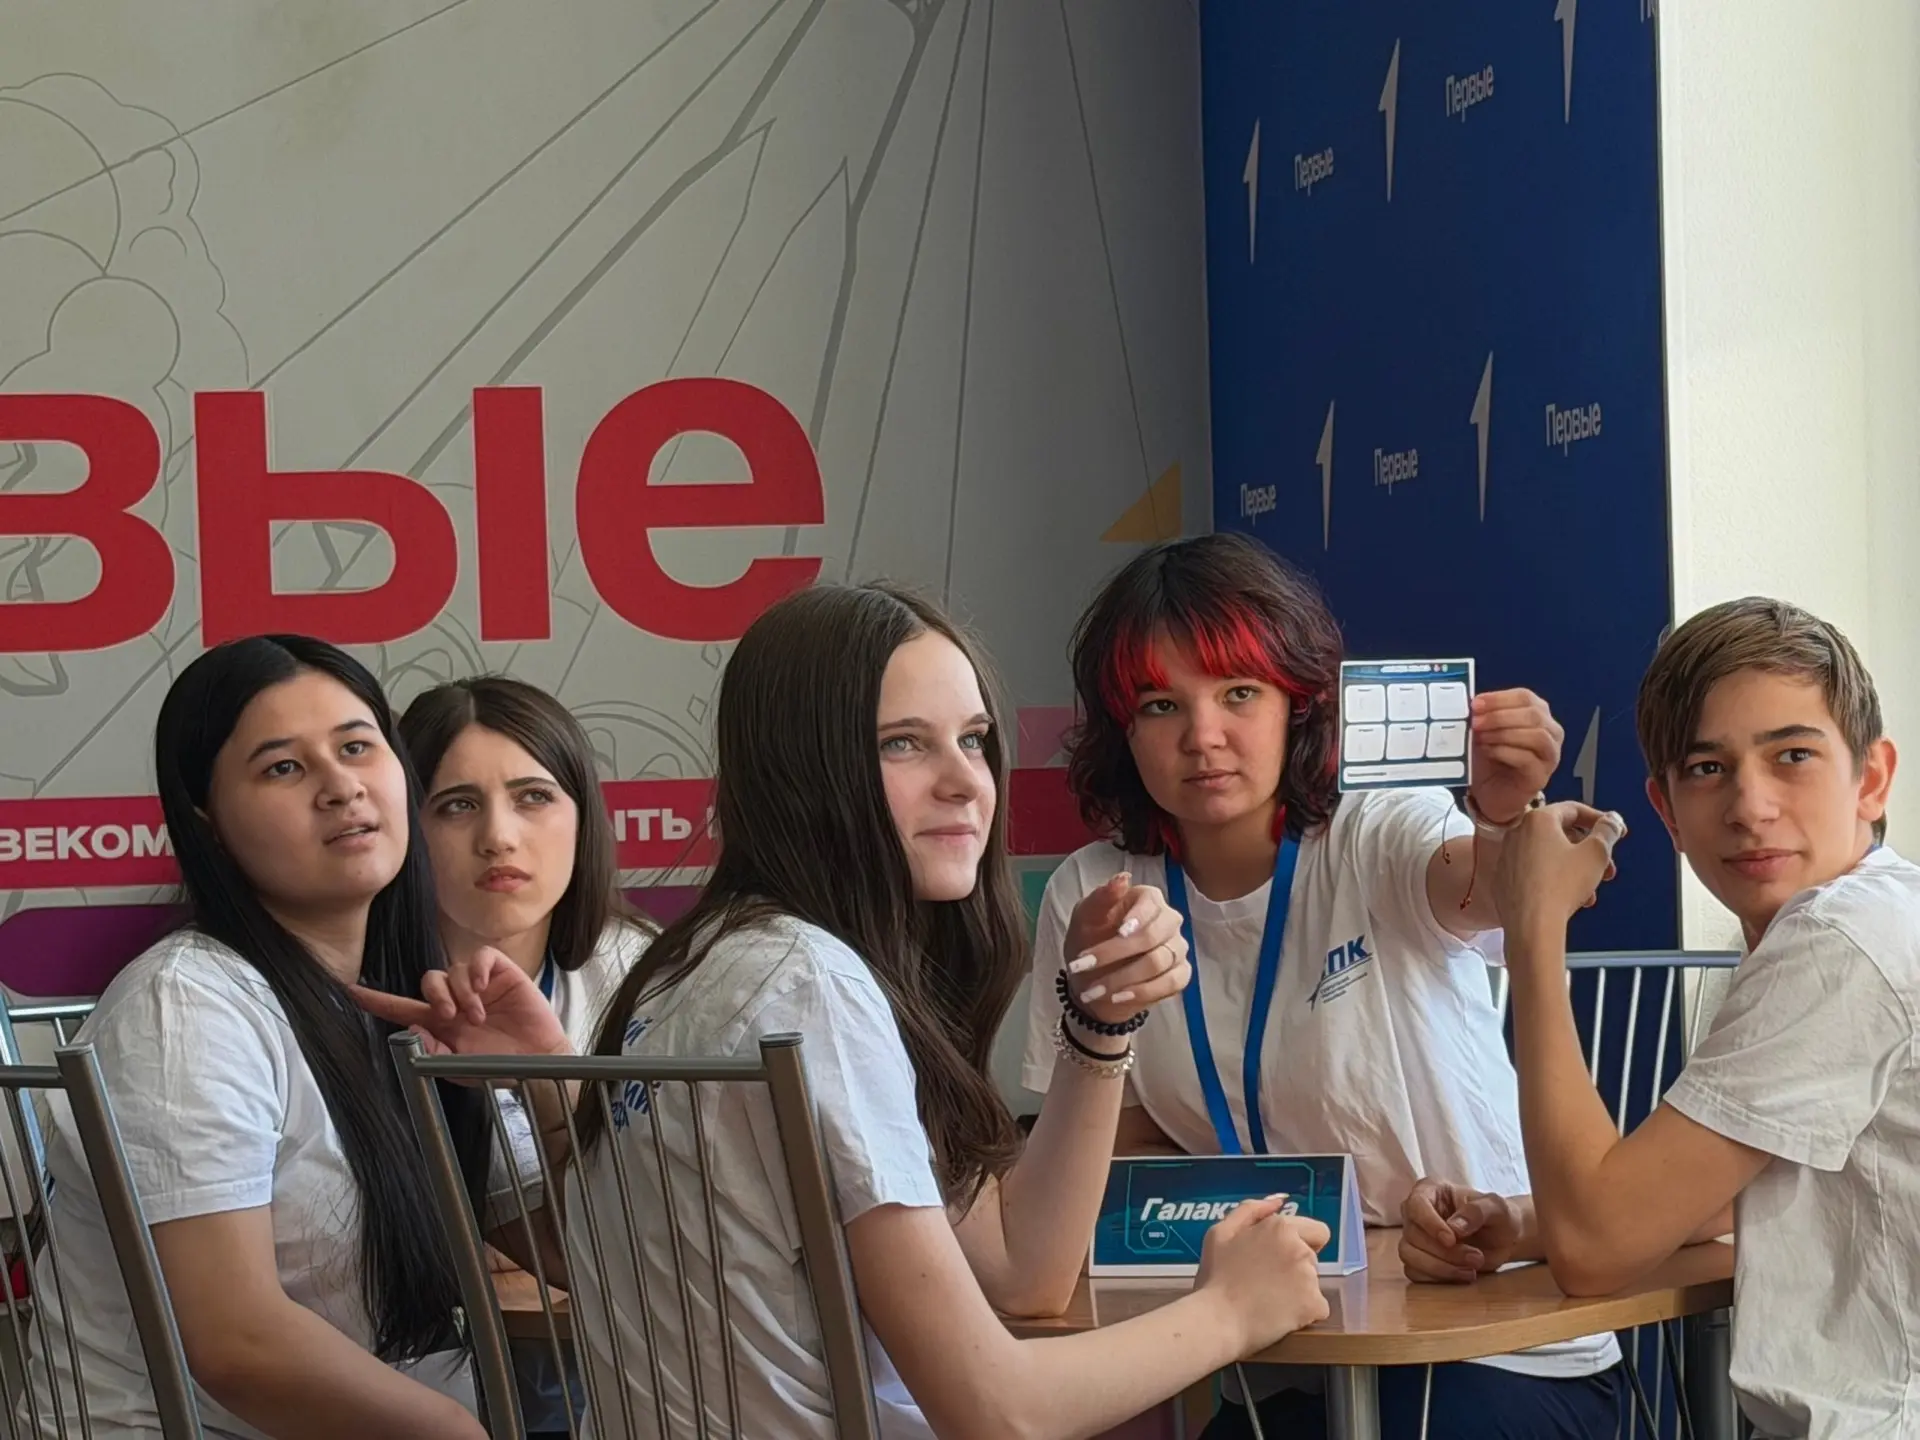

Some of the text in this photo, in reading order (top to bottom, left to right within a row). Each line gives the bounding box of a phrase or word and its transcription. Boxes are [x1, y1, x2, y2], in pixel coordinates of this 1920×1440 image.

[1445, 63, 1494, 123] Первые
[1294, 145, 1334, 197] Первые
[1545, 401, 1602, 456] Первые
[1374, 447, 1418, 495] Первые
[1240, 482, 1277, 526] Первые
[1139, 1196, 1300, 1221] Галака
